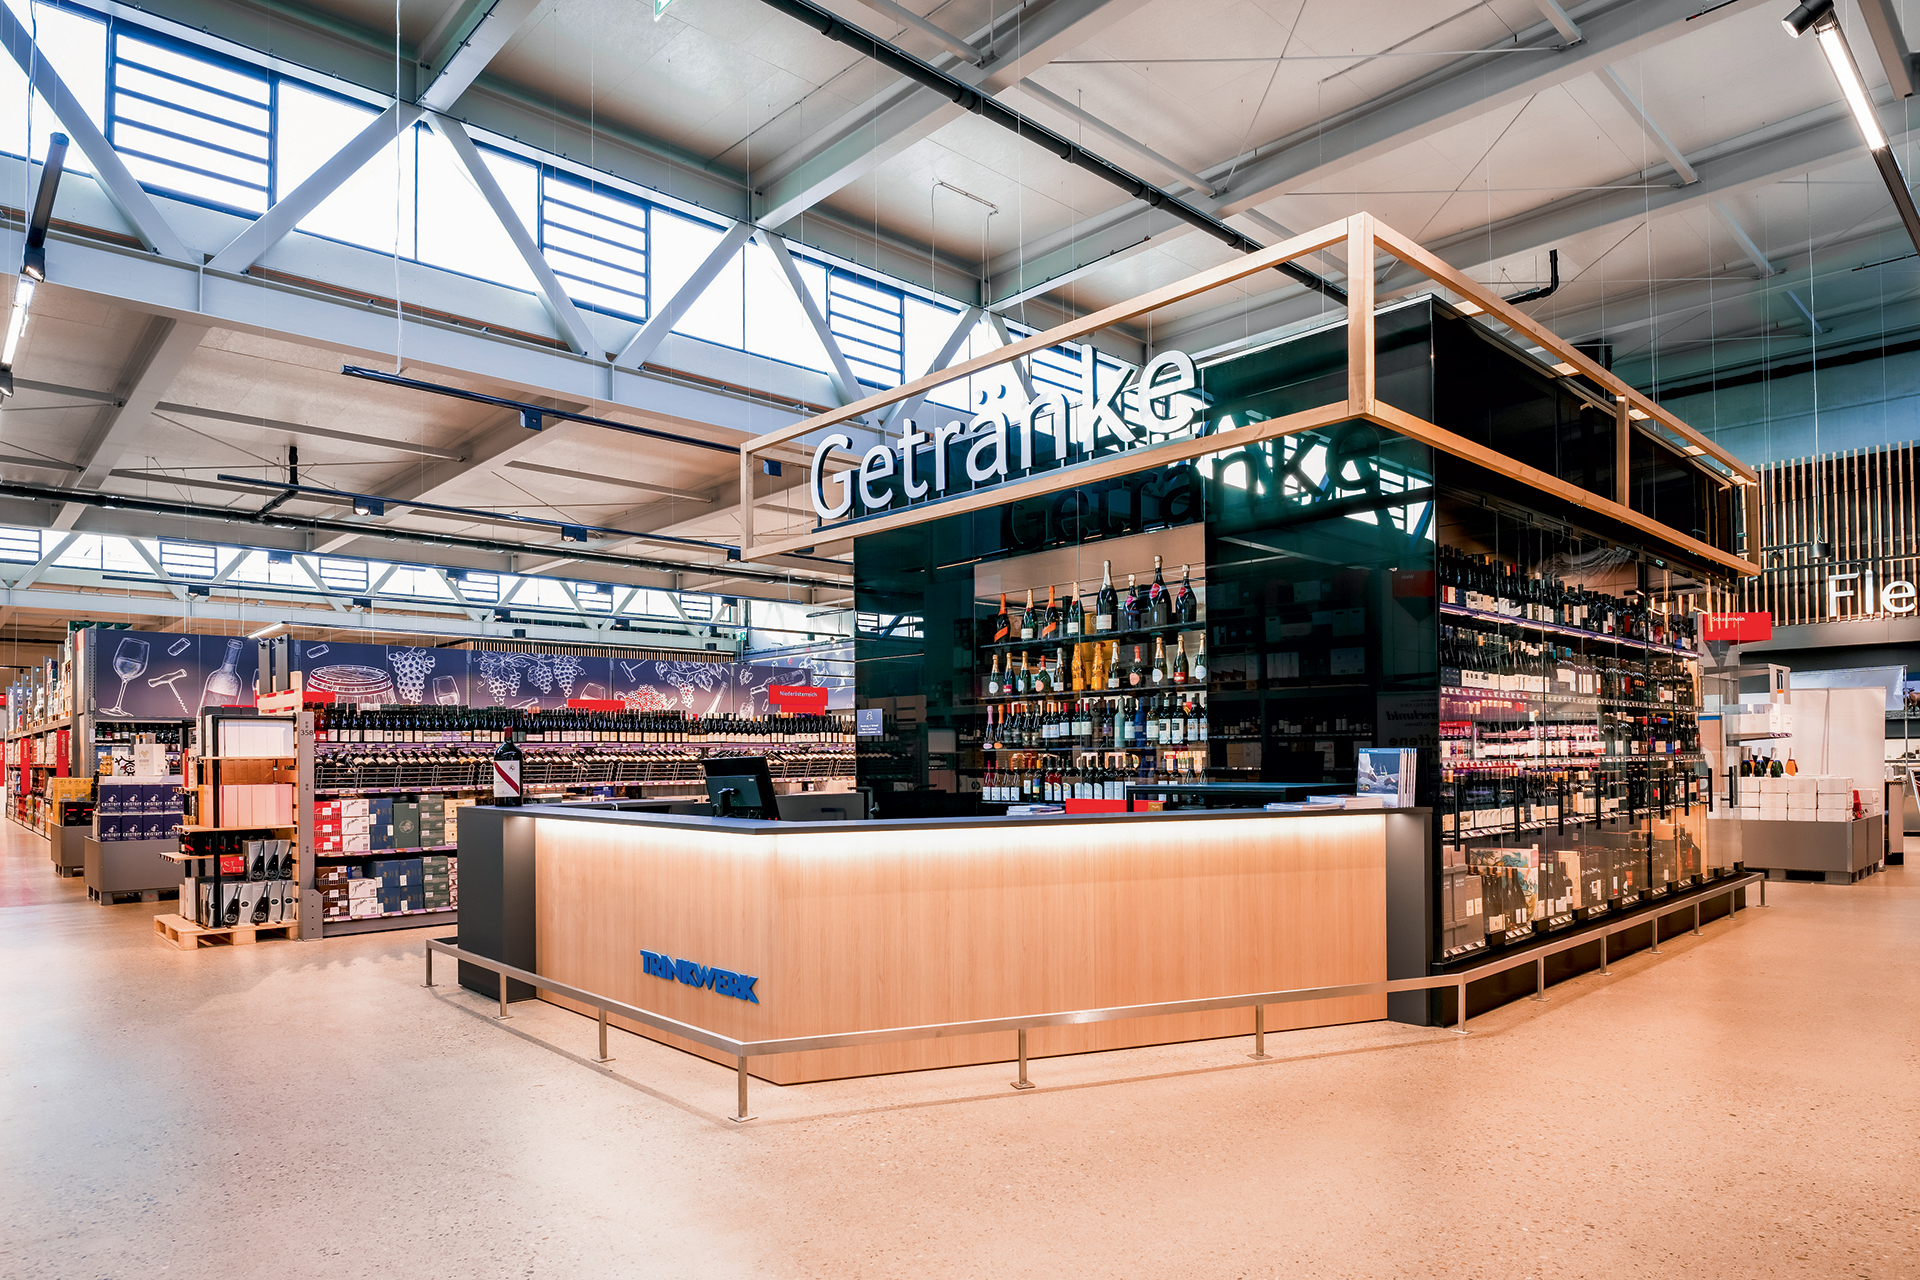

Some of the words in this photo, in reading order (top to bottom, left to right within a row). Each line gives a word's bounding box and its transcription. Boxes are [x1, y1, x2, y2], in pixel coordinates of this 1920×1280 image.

[810, 342, 1202, 520] Getränke
[1828, 569, 1916, 617] Fle
[639, 949, 760, 1004] TRINKWERK
